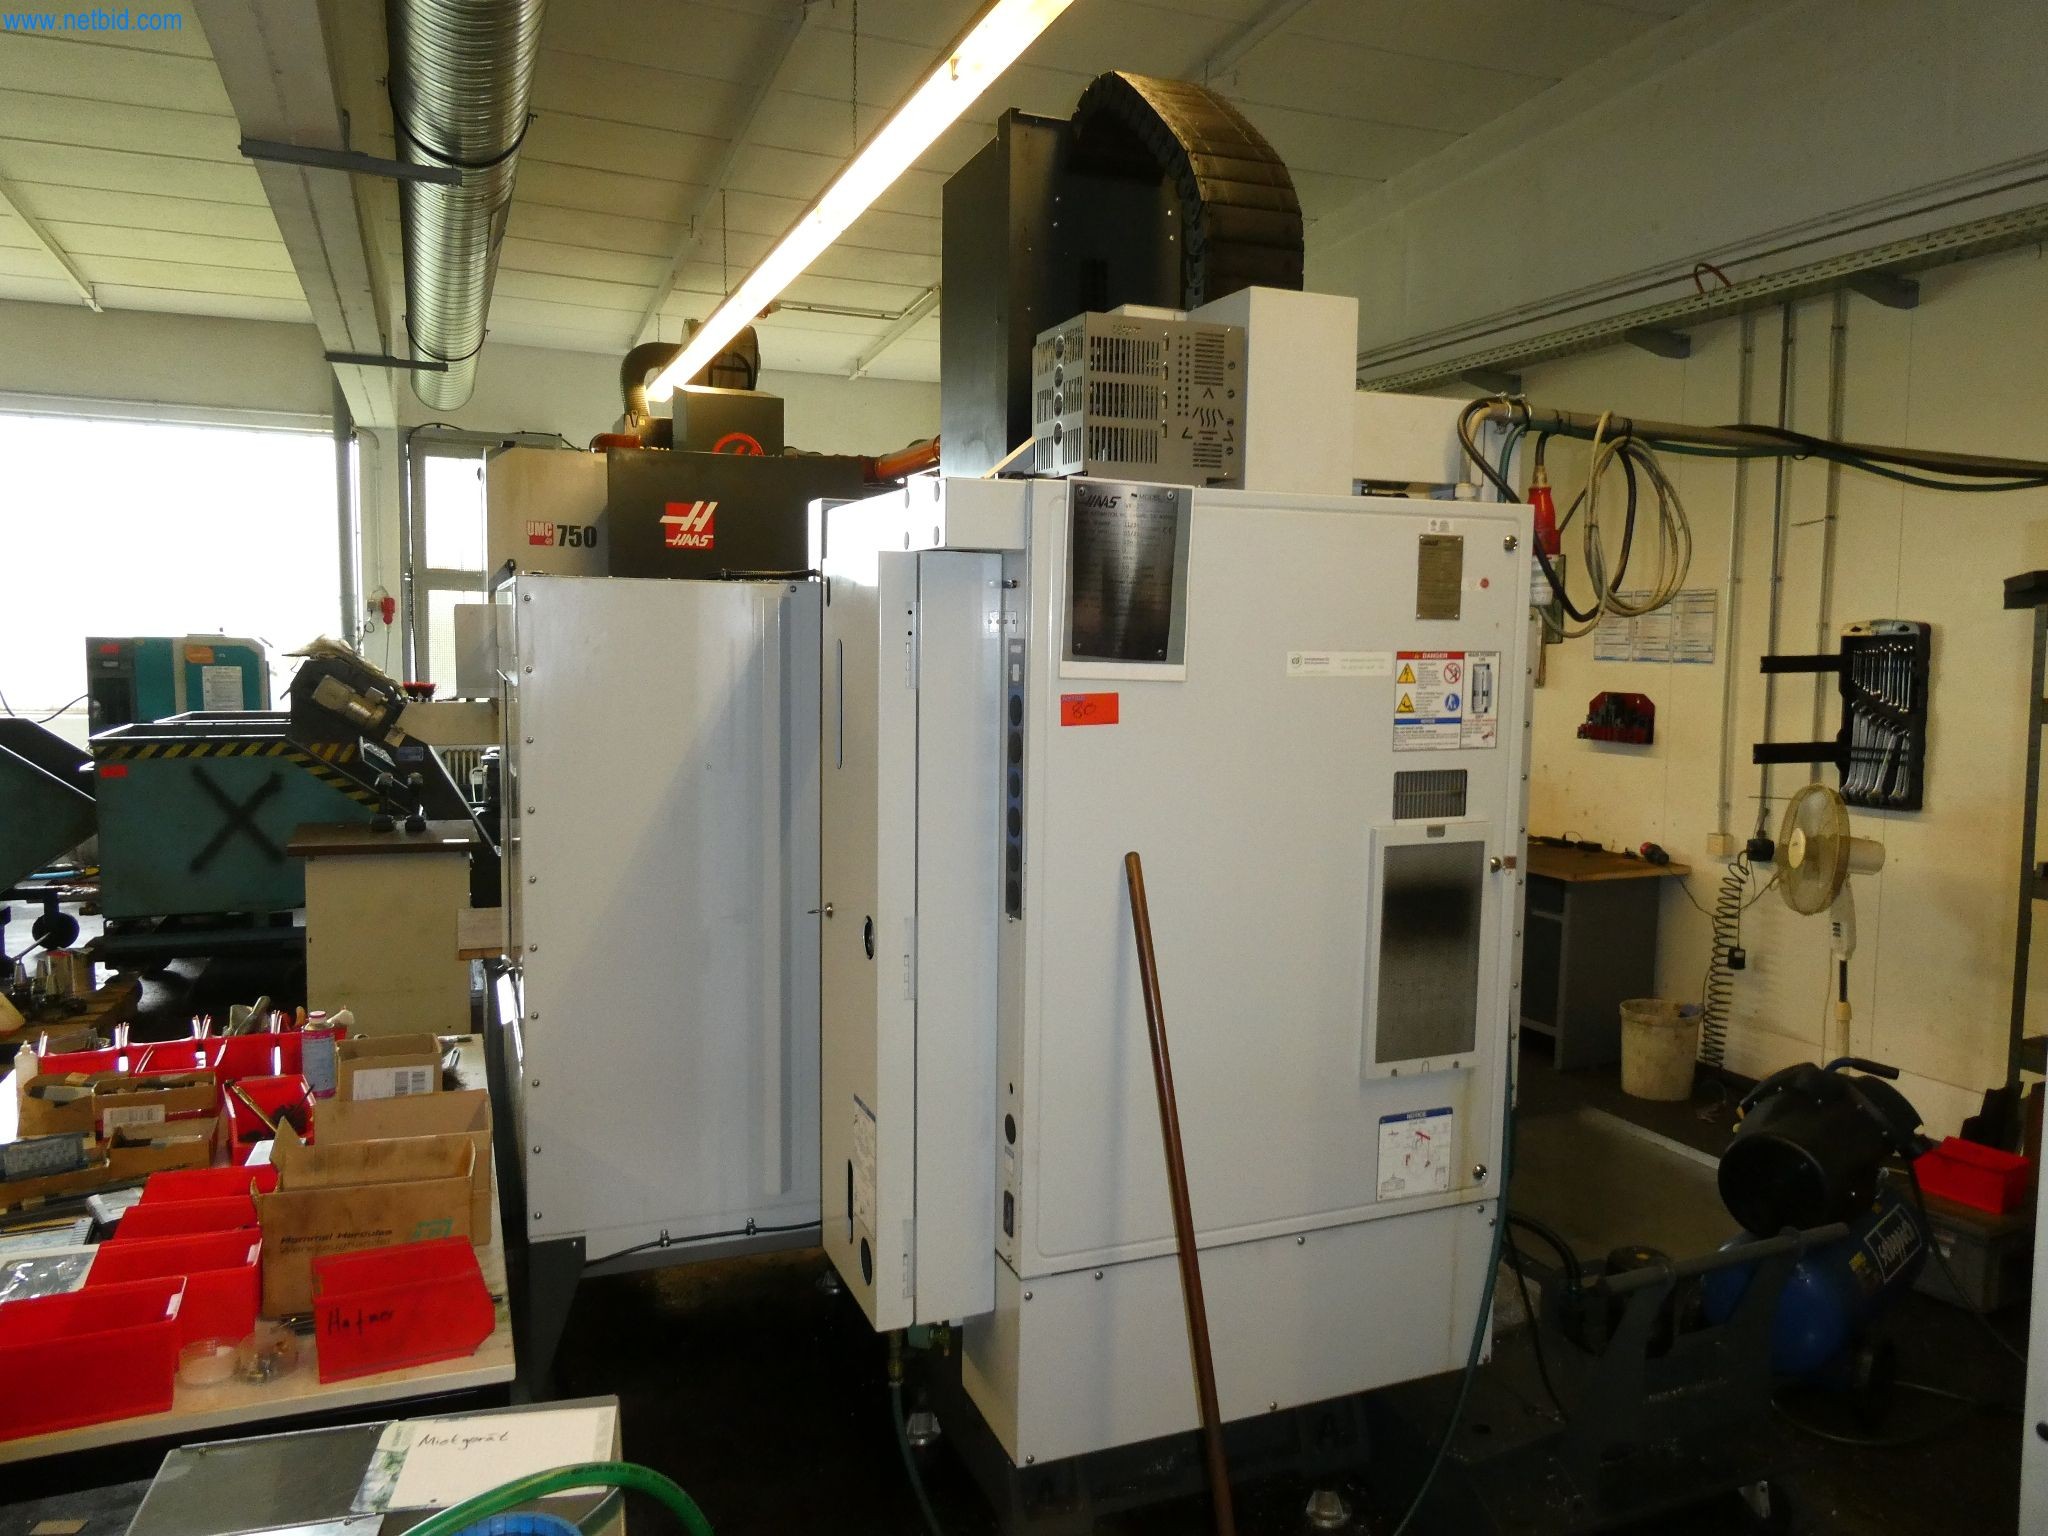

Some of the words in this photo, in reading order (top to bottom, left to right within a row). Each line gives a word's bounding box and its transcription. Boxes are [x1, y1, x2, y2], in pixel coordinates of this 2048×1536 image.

[527, 520, 553, 537] UMC
[556, 524, 598, 548] 750
[665, 532, 714, 548] HAAS
